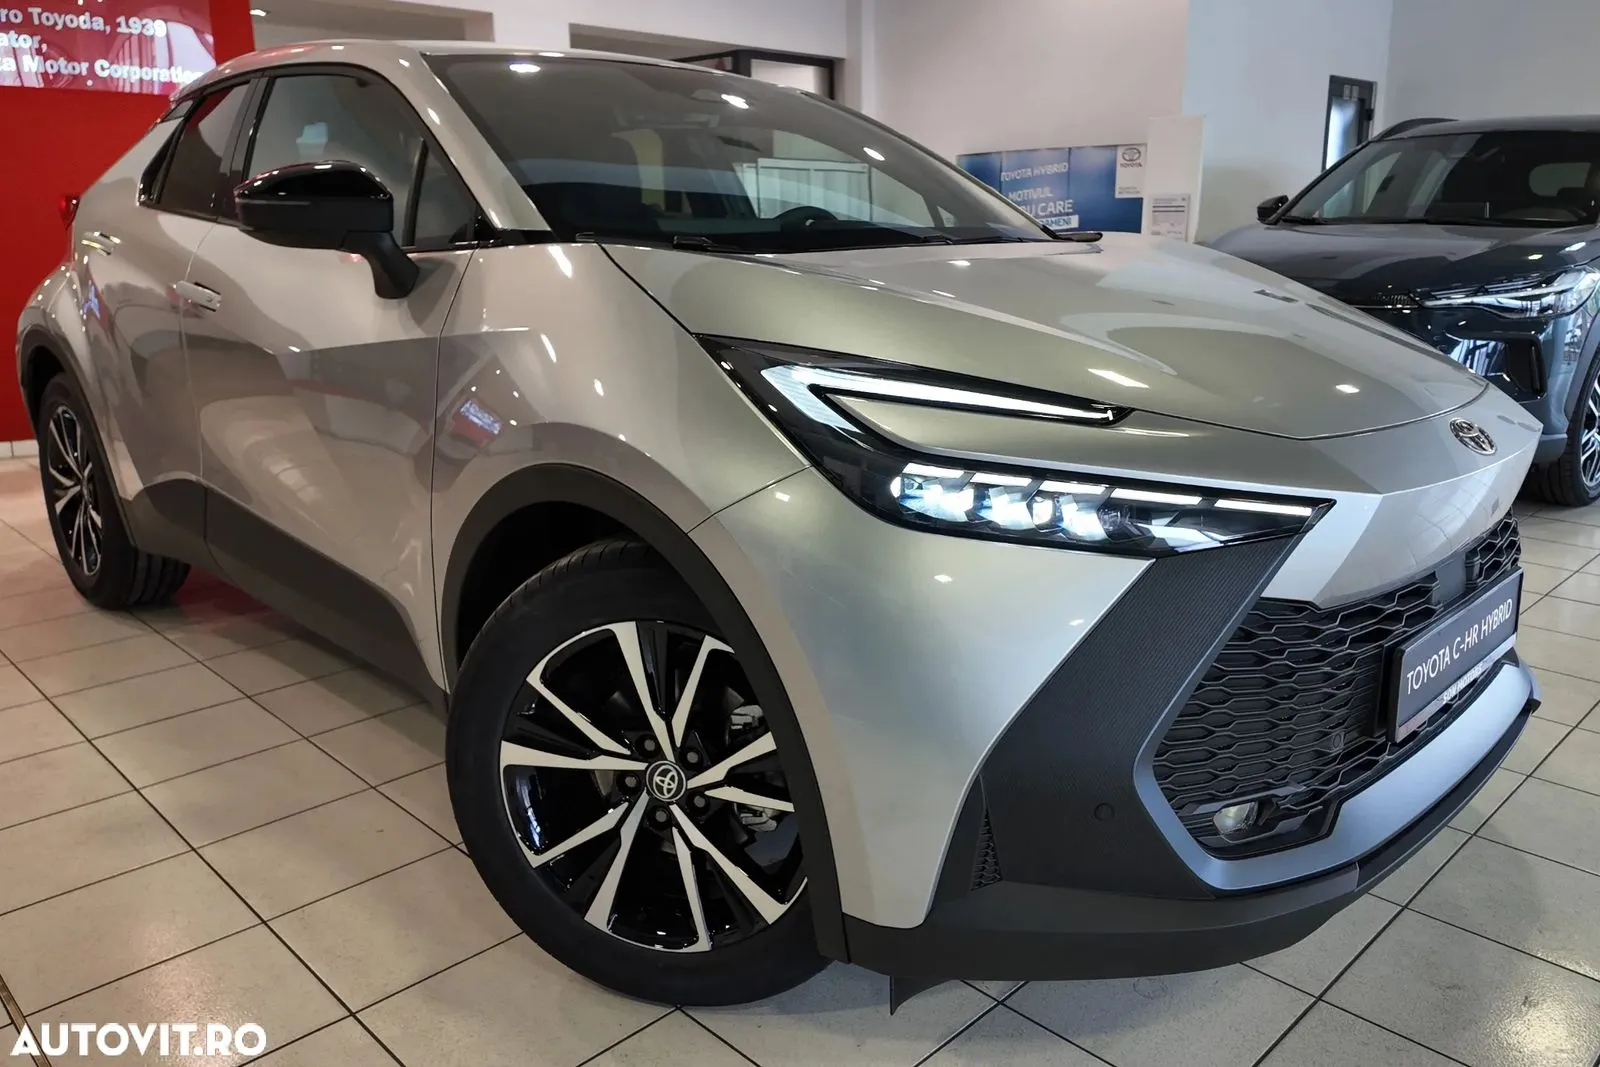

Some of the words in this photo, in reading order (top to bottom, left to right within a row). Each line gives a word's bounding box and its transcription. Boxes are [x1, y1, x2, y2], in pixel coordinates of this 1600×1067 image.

[28, 7, 111, 35] Toyoda,
[22, 54, 90, 76] Motor
[1001, 168, 1032, 181] TOYOTA
[1034, 162, 1068, 177] HYBRID
[1037, 199, 1073, 216] CARE
[1407, 645, 1451, 695] TOYOTA
[1453, 623, 1478, 660] C-HR
[1480, 598, 1513, 640] HYBRID
